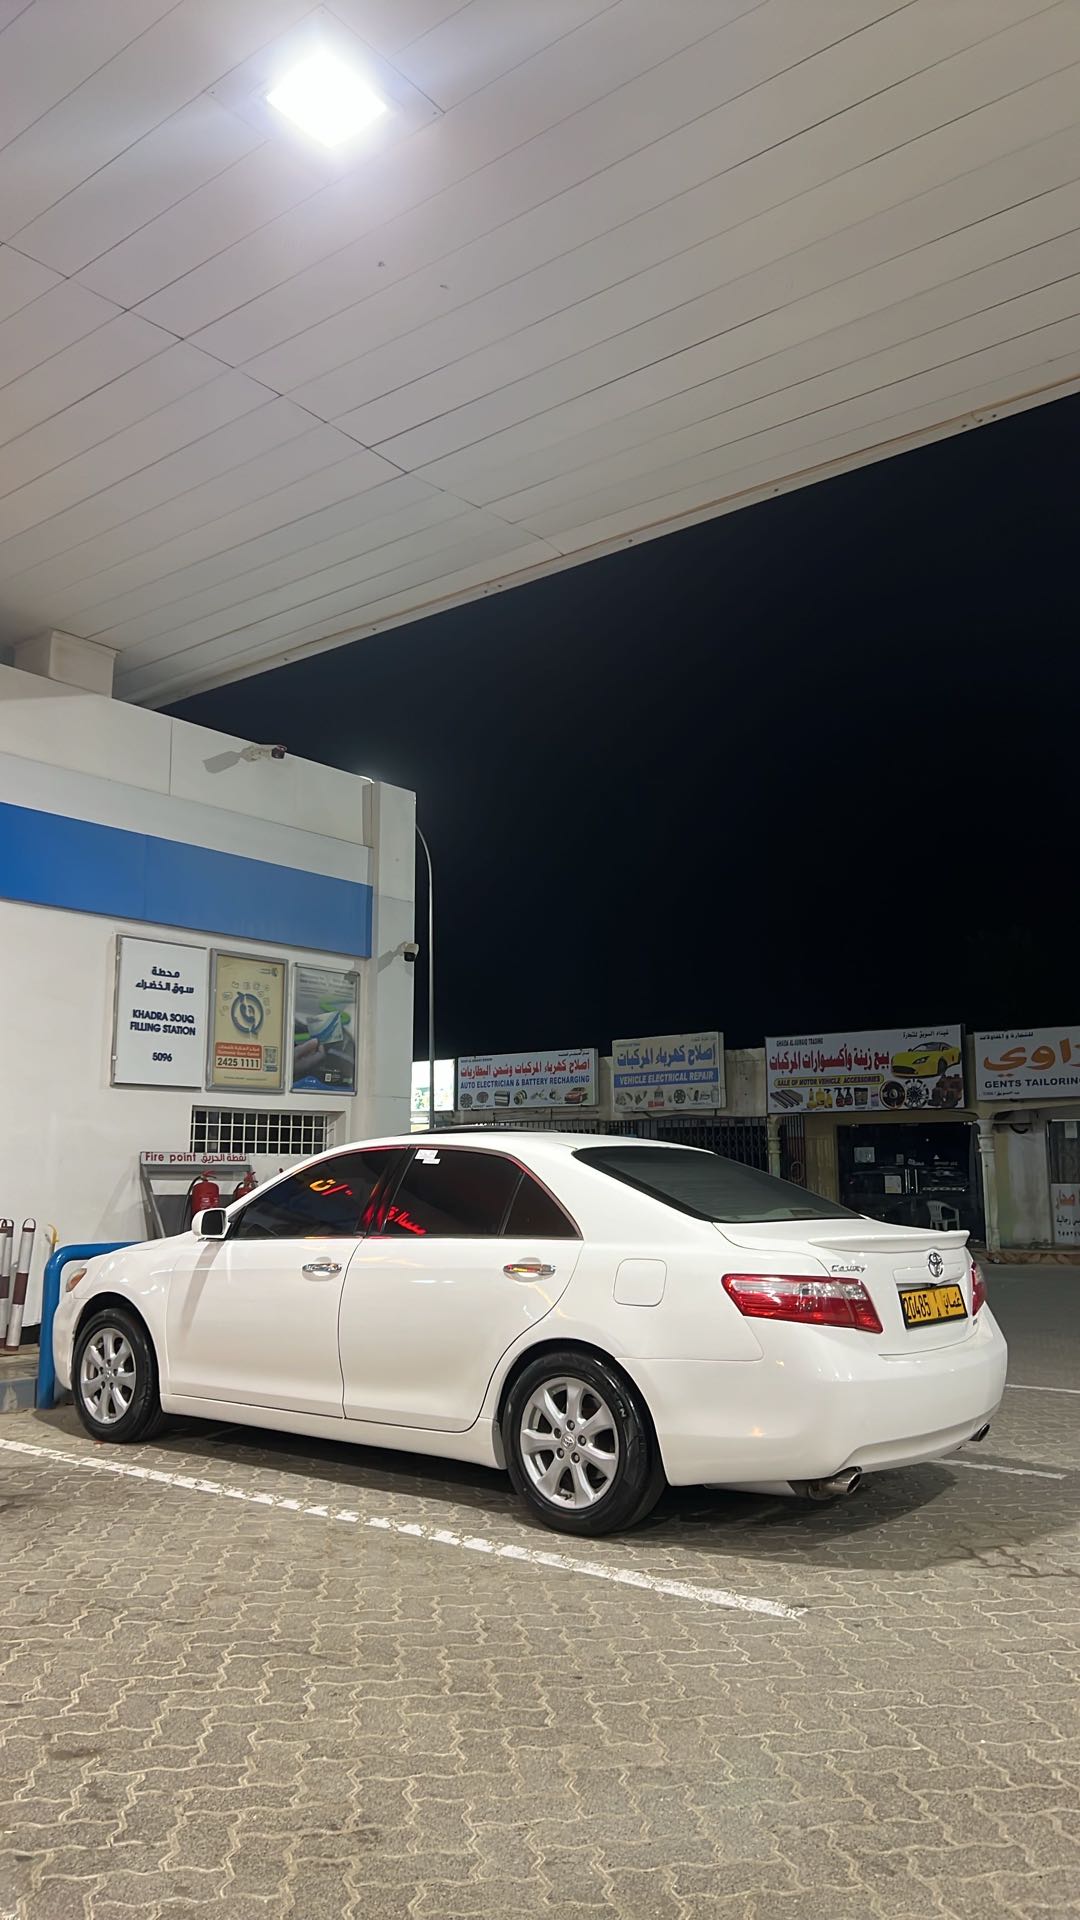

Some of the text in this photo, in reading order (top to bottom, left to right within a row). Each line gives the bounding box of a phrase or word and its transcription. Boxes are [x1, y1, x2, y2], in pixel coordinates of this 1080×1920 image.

[152, 966, 180, 978] محطة
[135, 979, 194, 994] سوق الخضراء
[132, 1009, 195, 1024] KHADRA SOUQ
[130, 1021, 196, 1036] FILLING STATION
[152, 1052, 173, 1062] 5096
[217, 1057, 259, 1068] 2425 1111
[617, 1047, 654, 1069] المركبات
[655, 1044, 686, 1067] كهرباء
[769, 1050, 801, 1074] المركبات
[853, 1047, 873, 1071] زينة
[874, 1051, 889, 1070] بيع
[514, 1062, 542, 1077] المركبات
[544, 1060, 566, 1075] كهرباء
[460, 1075, 590, 1090] AUTO ELECTRICIAN & BATTERY RECHARGING
[620, 1070, 714, 1085] VEHICLE ELECTRICAL REPAIR
[818, 1077, 841, 1085] VEHICLE
[843, 1075, 881, 1083] ACCESSORIES
[984, 1076, 1080, 1089] GENTS TAILORIN
[145, 1152, 197, 1164] Fire point
[200, 1152, 247, 1164] نقطة الحريق
[902, 1293, 932, 1320] 20485
